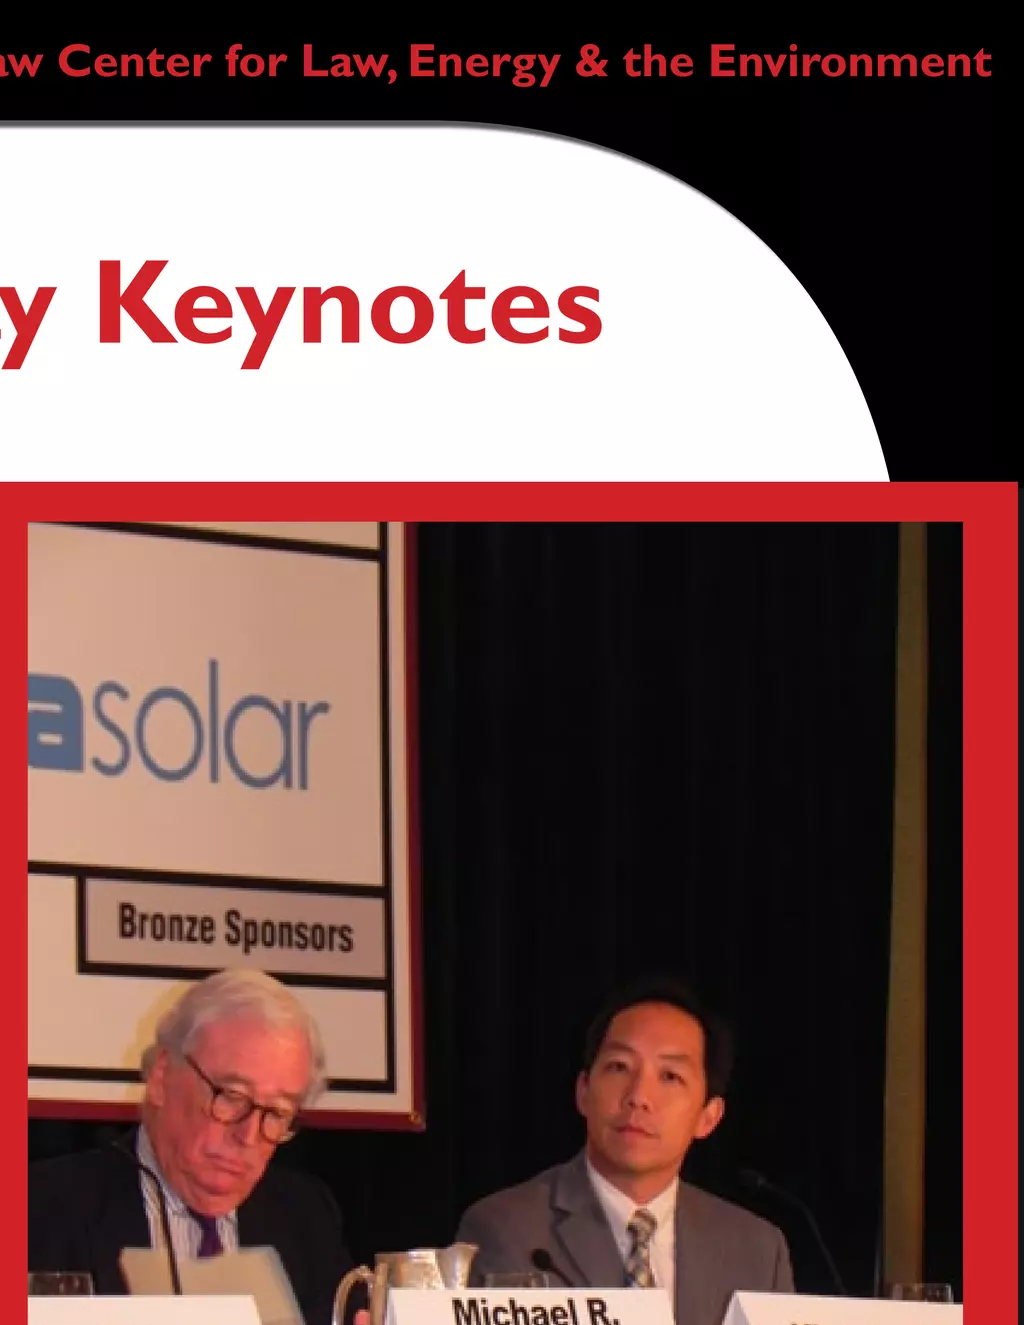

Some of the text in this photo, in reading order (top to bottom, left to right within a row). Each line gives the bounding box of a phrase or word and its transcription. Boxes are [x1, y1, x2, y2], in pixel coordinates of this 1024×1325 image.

[59, 44, 212, 76] Center
[226, 44, 287, 76] for
[304, 44, 397, 84] Law,
[411, 44, 560, 87] Energy
[576, 44, 608, 76] &
[623, 44, 693, 76] the
[711, 44, 991, 76] Environment
[100, 260, 602, 369] Keynotes
[118, 901, 354, 955] Bronze Sponsors
